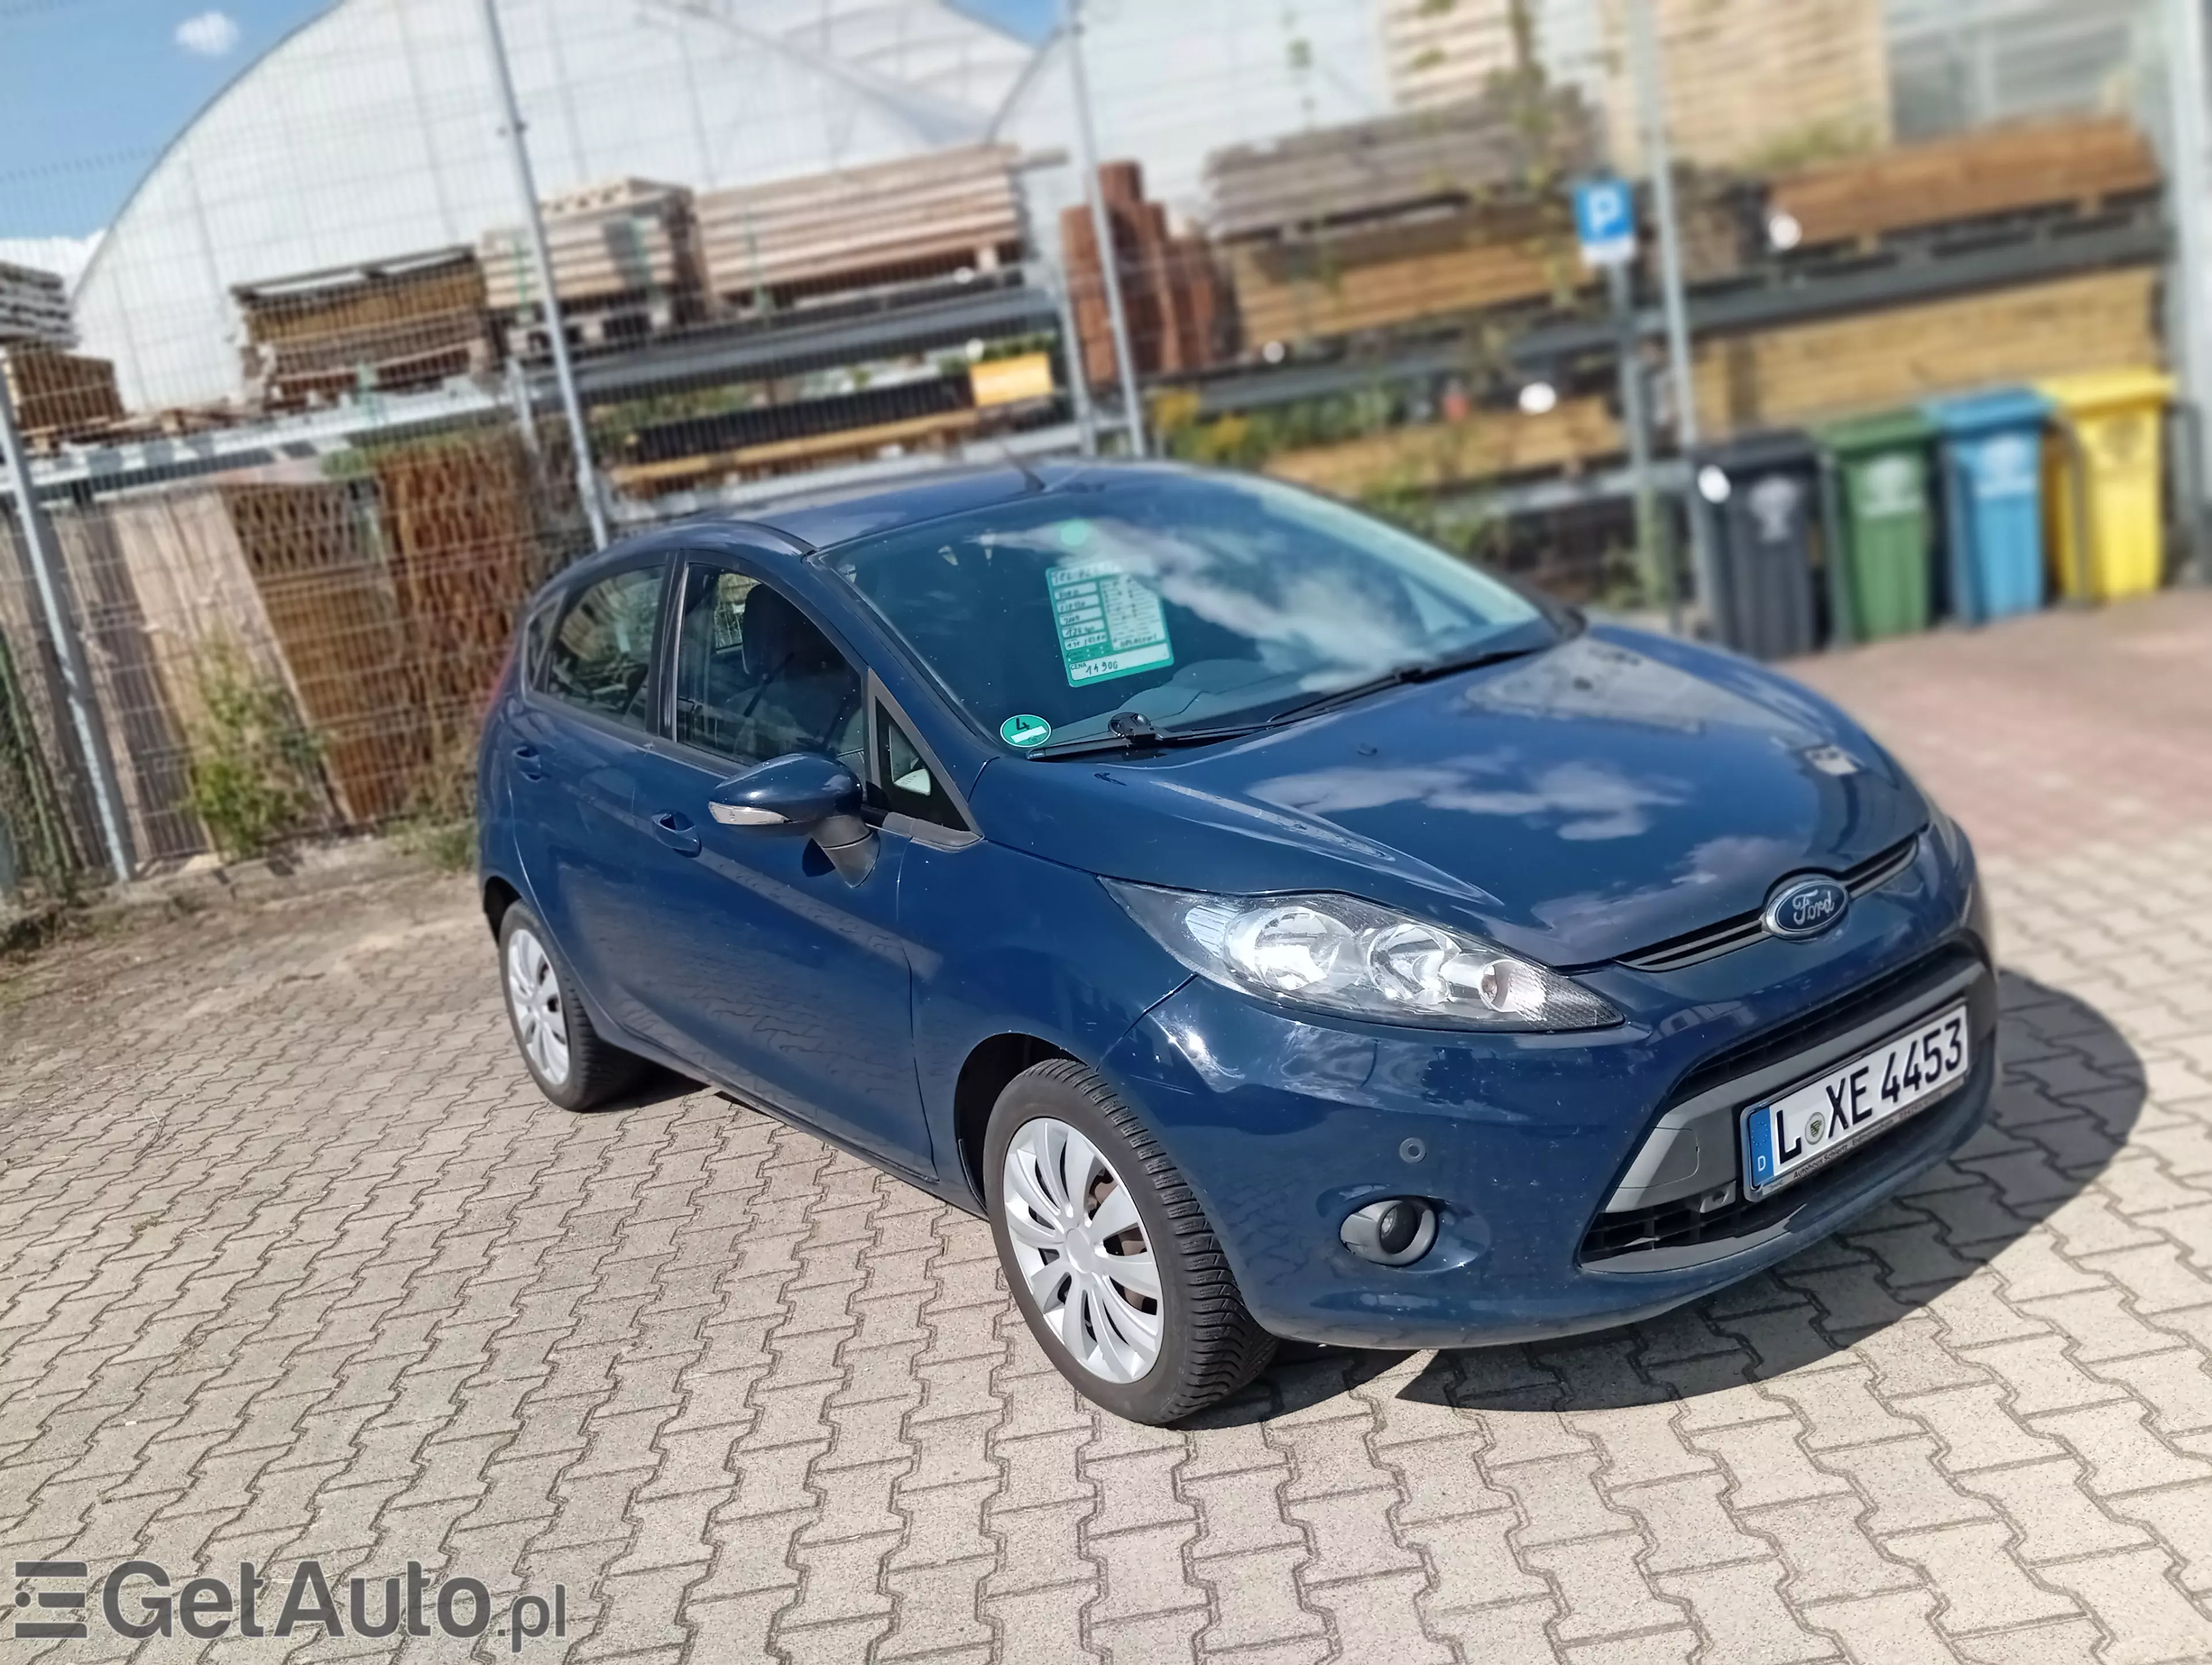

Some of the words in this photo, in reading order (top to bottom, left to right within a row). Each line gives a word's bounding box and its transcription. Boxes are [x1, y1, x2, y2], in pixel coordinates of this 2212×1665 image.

[1589, 188, 1622, 233] P
[1070, 662, 1086, 670] CENA
[1792, 889, 1835, 925] Ford
[1776, 1109, 1802, 1165] L
[1825, 1065, 1873, 1139] XE
[1880, 1017, 1961, 1103] 4453
[1757, 1155, 1766, 1173] D
